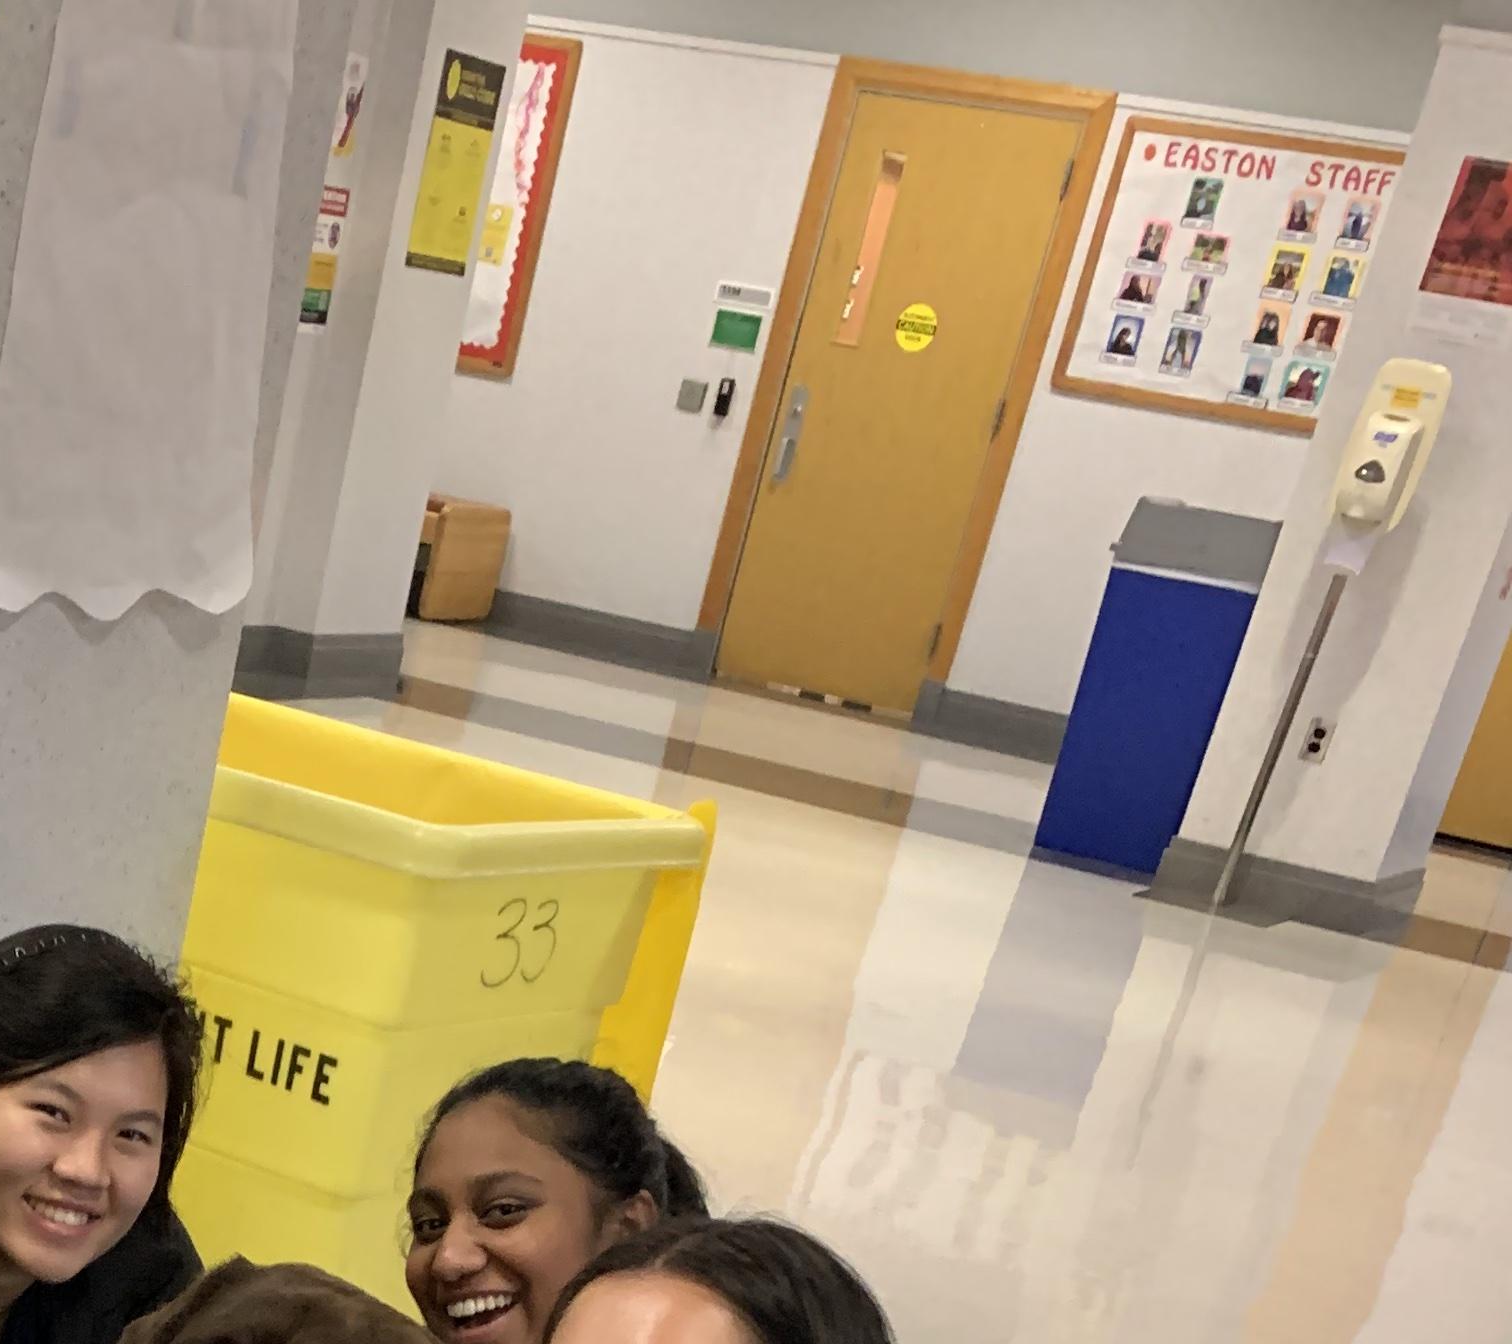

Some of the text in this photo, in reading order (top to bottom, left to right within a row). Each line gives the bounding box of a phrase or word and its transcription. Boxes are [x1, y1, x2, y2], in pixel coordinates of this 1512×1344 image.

[1163, 141, 1397, 196] EASTON STAFF
[480, 897, 560, 988] 33
[245, 1028, 338, 1106] LIFE
